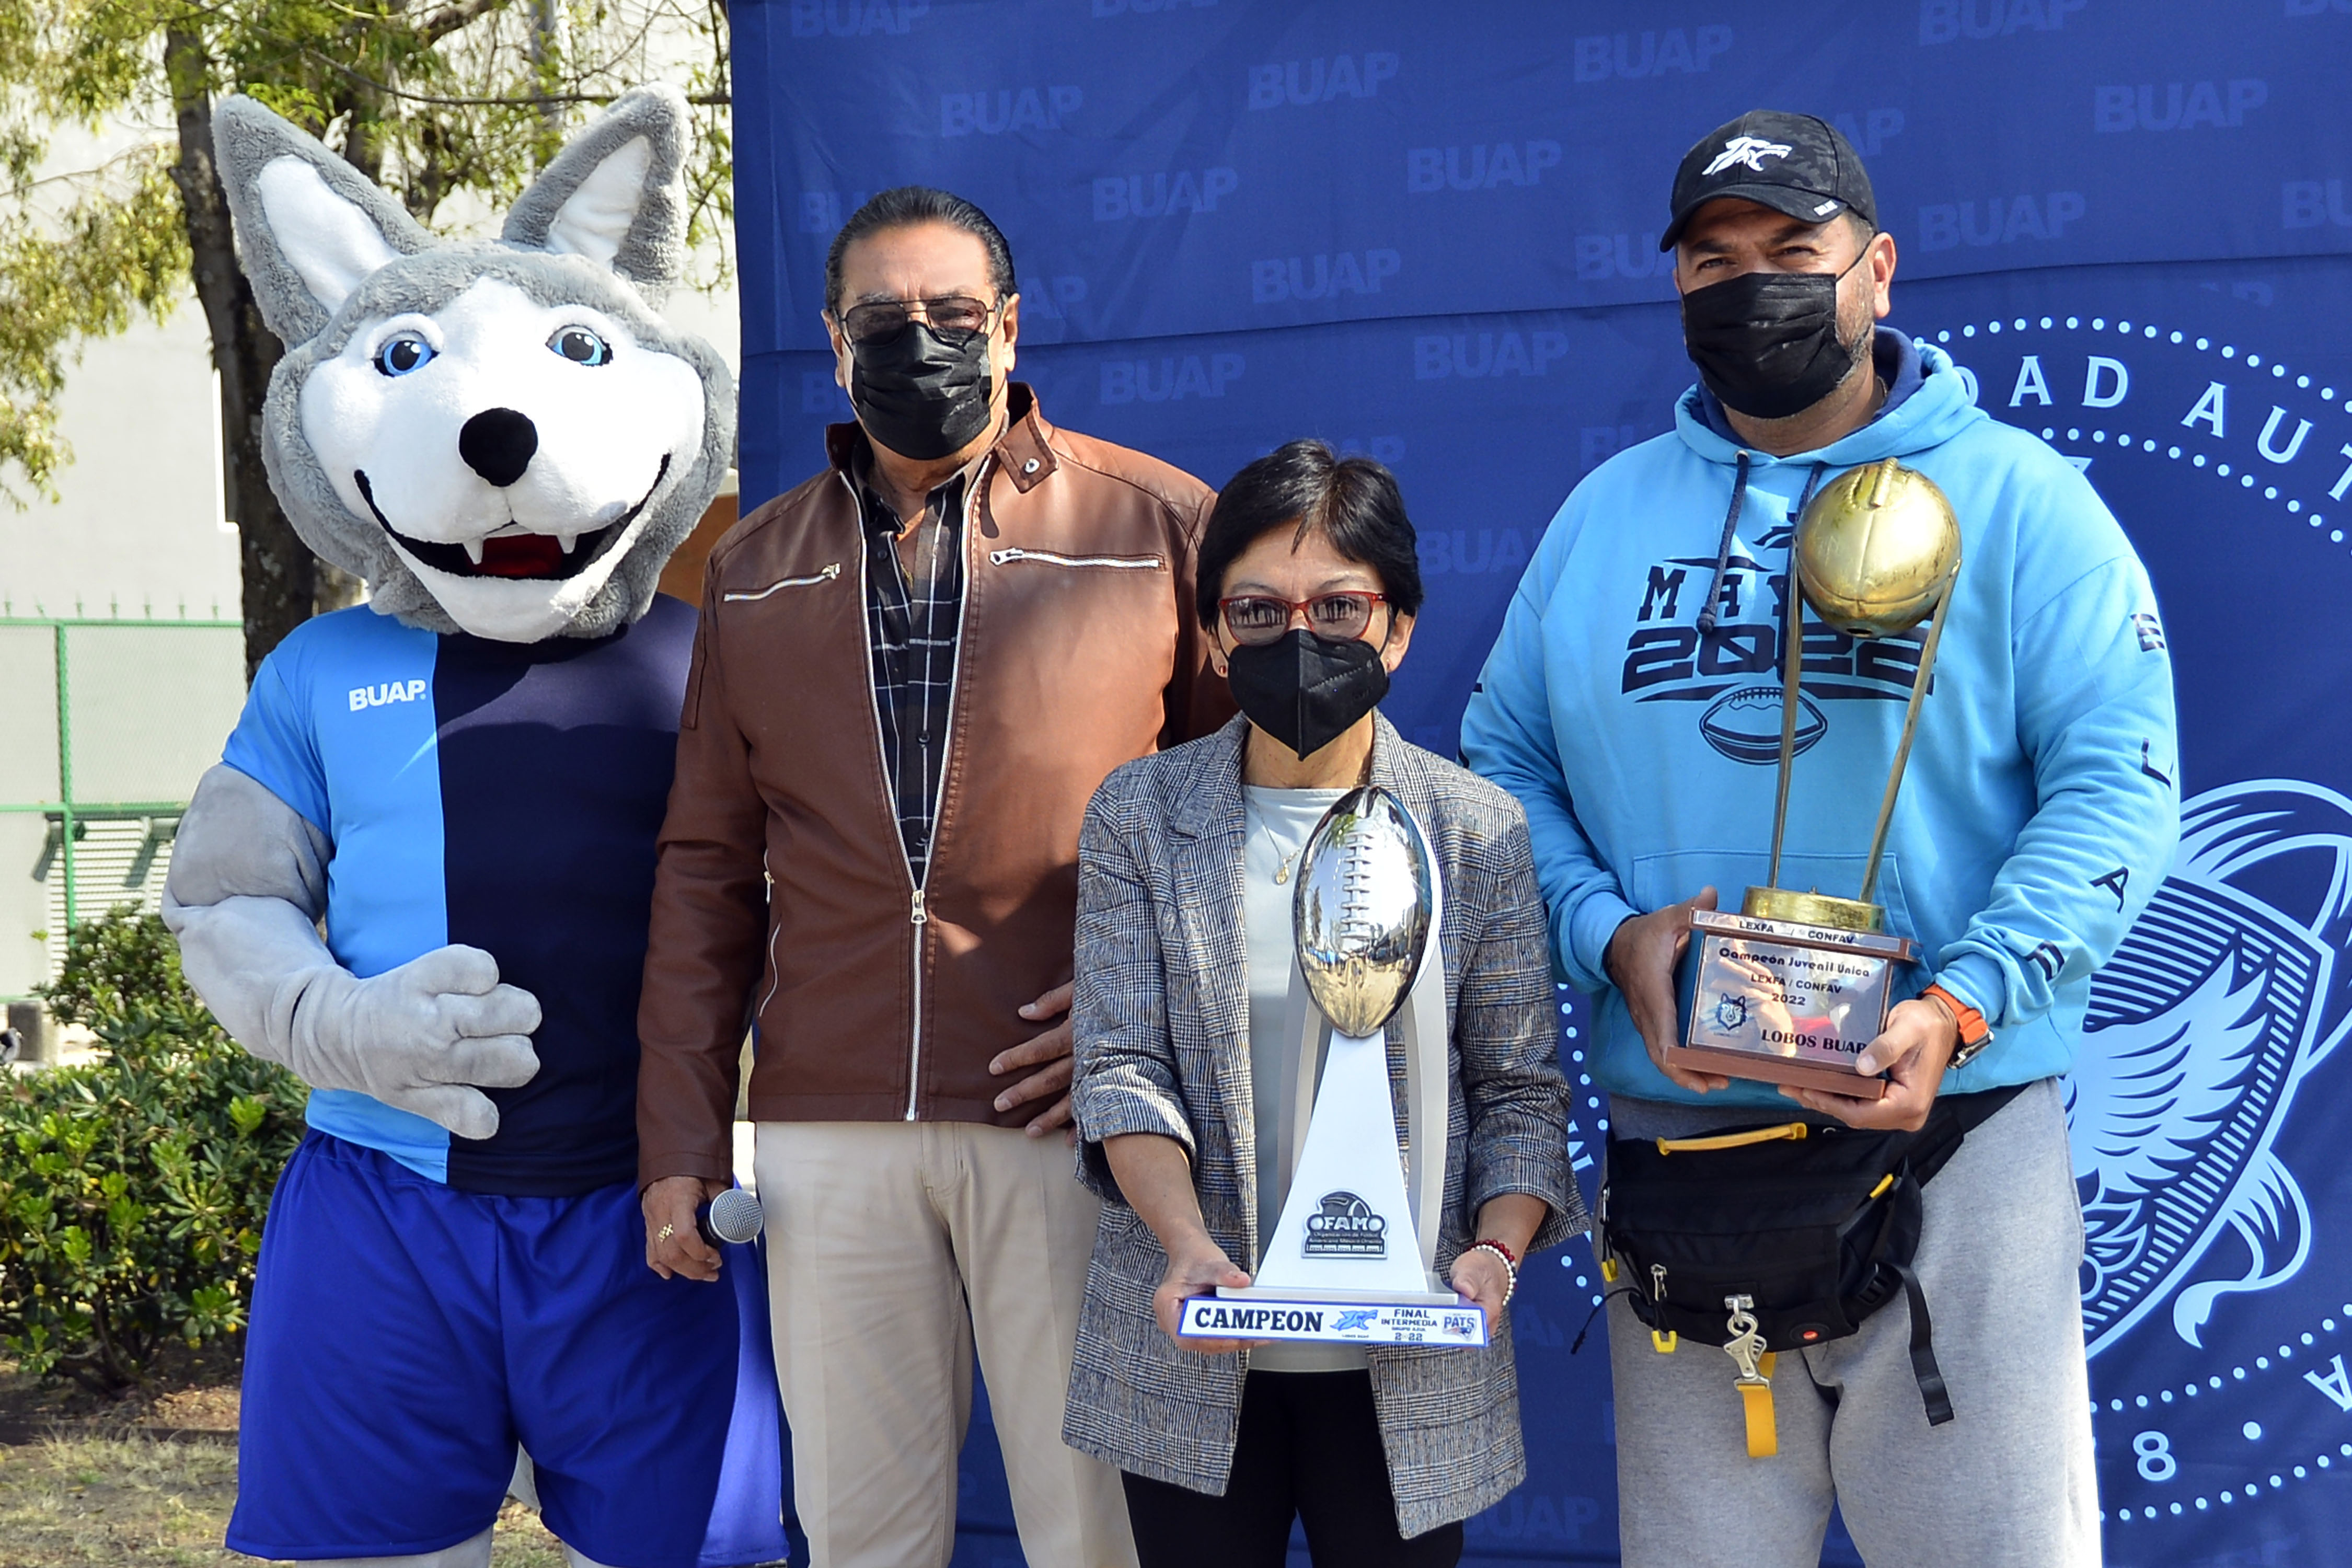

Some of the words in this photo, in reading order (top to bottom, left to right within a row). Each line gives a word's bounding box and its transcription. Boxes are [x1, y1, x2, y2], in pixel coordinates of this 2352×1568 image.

[790, 0, 931, 38] BUAP
[1574, 24, 1733, 83] BUAP
[1248, 52, 1399, 111] BUAP
[941, 85, 1083, 137] BUAP
[2094, 78, 2269, 133] BUAP
[1834, 107, 1906, 157] AP
[1407, 140, 1562, 194] BUAP
[1092, 167, 1238, 222] BUAP
[1918, 191, 2086, 252] BUAP
[1019, 275, 1089, 321] AP
[1253, 248, 1401, 304] BUAP
[1100, 352, 1246, 406] BUAP
[1414, 331, 1567, 381] BUAP
[1416, 527, 1542, 574] BUA
[1621, 623, 1935, 697] 2022
[349, 679, 426, 712] BUAP
[1739, 920, 1774, 934] LEXFA
[1807, 930, 1854, 944] CONFAV
[1750, 973, 1786, 987] LEXFA
[1796, 979, 1842, 994] CONFAV
[1788, 956, 1834, 972] Juvenil
[1771, 993, 1806, 1006] 2022
[1761, 1029, 1817, 1048] LOBOS
[1822, 1037, 1868, 1054] BUAP
[1194, 1307, 1324, 1332] CAMPEON
[1381, 1318, 1437, 1327] INTERMEDIA
[1393, 1308, 1430, 1319] FINAL
[1443, 1316, 1475, 1330] PATS
